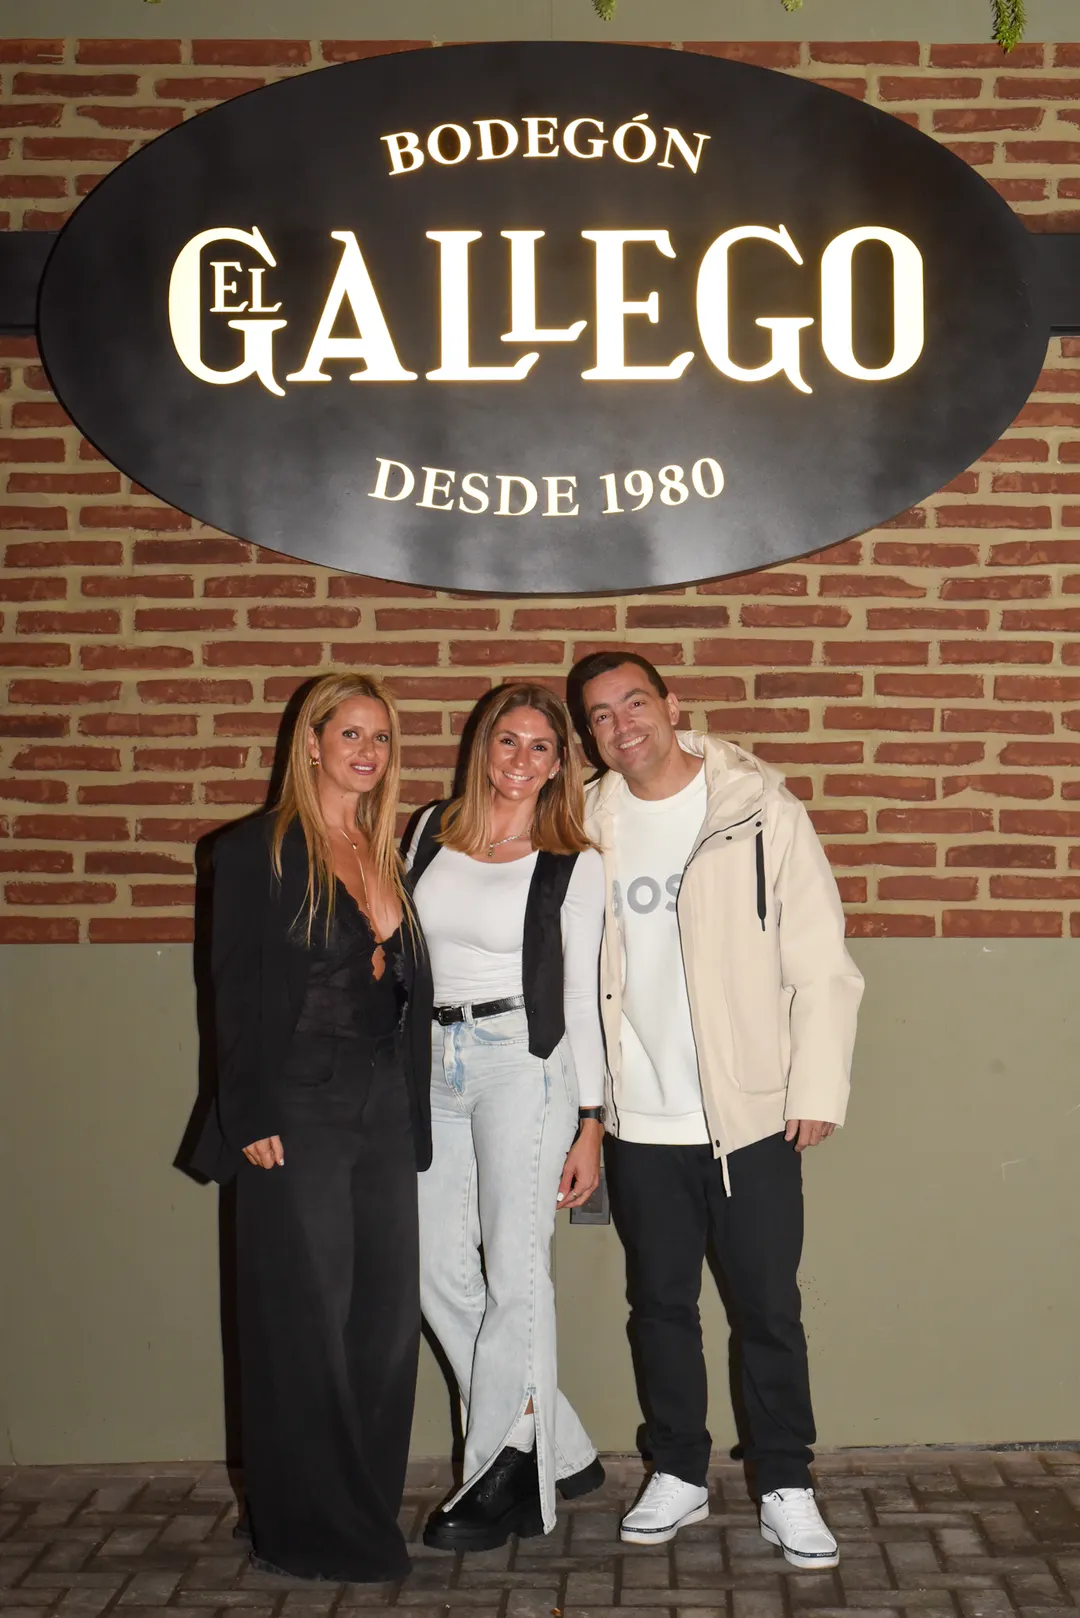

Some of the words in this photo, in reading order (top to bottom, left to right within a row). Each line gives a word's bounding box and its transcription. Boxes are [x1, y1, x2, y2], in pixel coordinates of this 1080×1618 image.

[380, 113, 712, 176] BODEGÓN
[168, 224, 925, 396] GALLEGO
[209, 262, 283, 313] EL
[367, 457, 580, 517] DESDE
[599, 457, 725, 514] 1980
